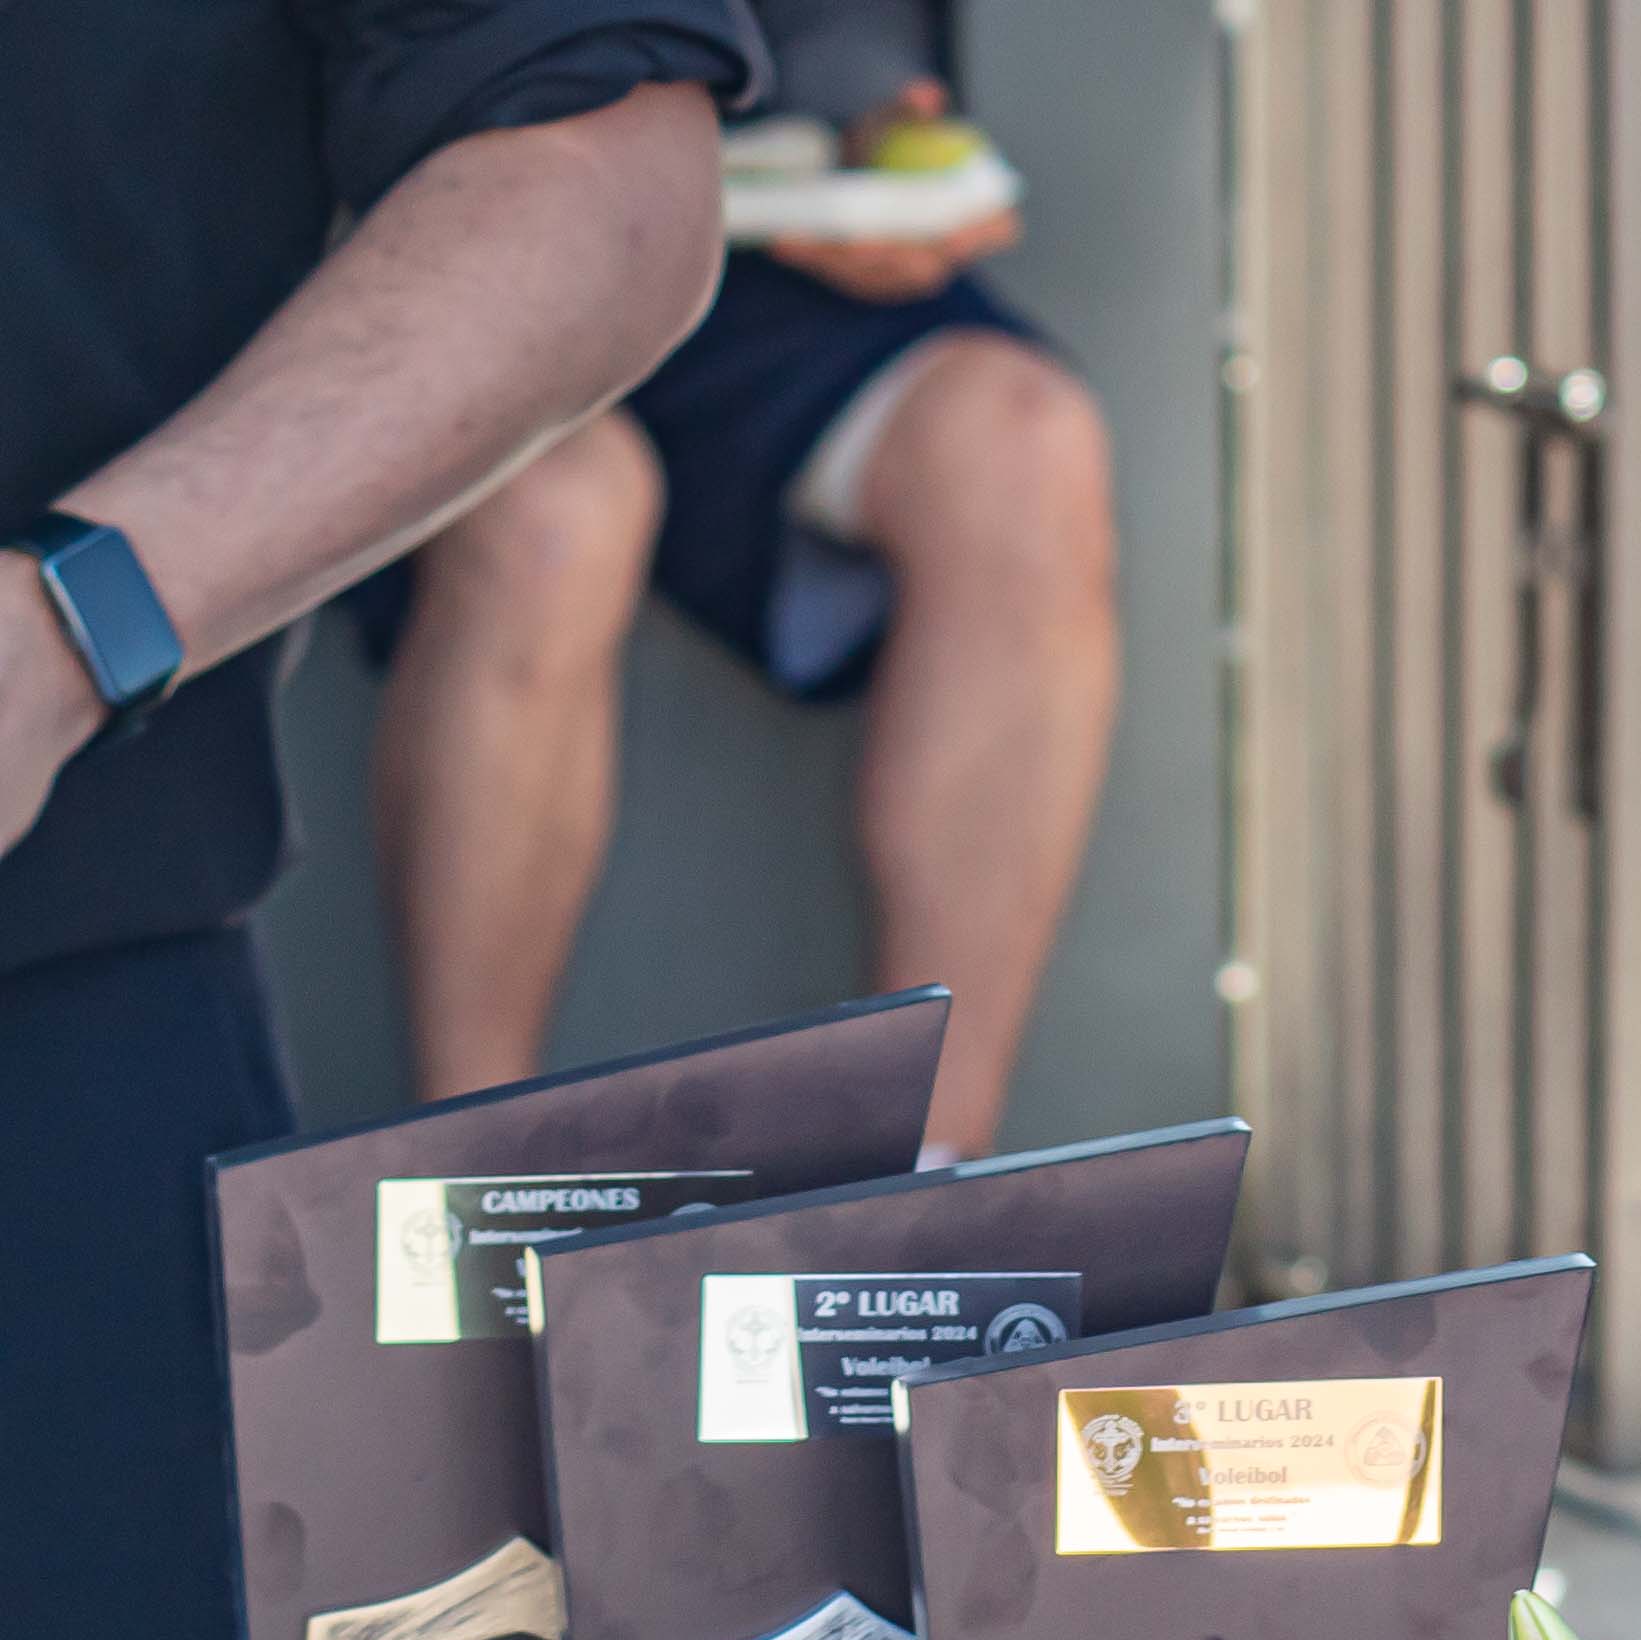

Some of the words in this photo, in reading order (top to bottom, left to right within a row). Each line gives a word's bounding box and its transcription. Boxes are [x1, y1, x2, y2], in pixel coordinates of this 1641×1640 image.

[481, 1187, 641, 1214] CAMPEONES
[857, 1290, 960, 1316] LUGAR
[1218, 1399, 1314, 1422] LUGAR
[1290, 1433, 1335, 1449] 2024
